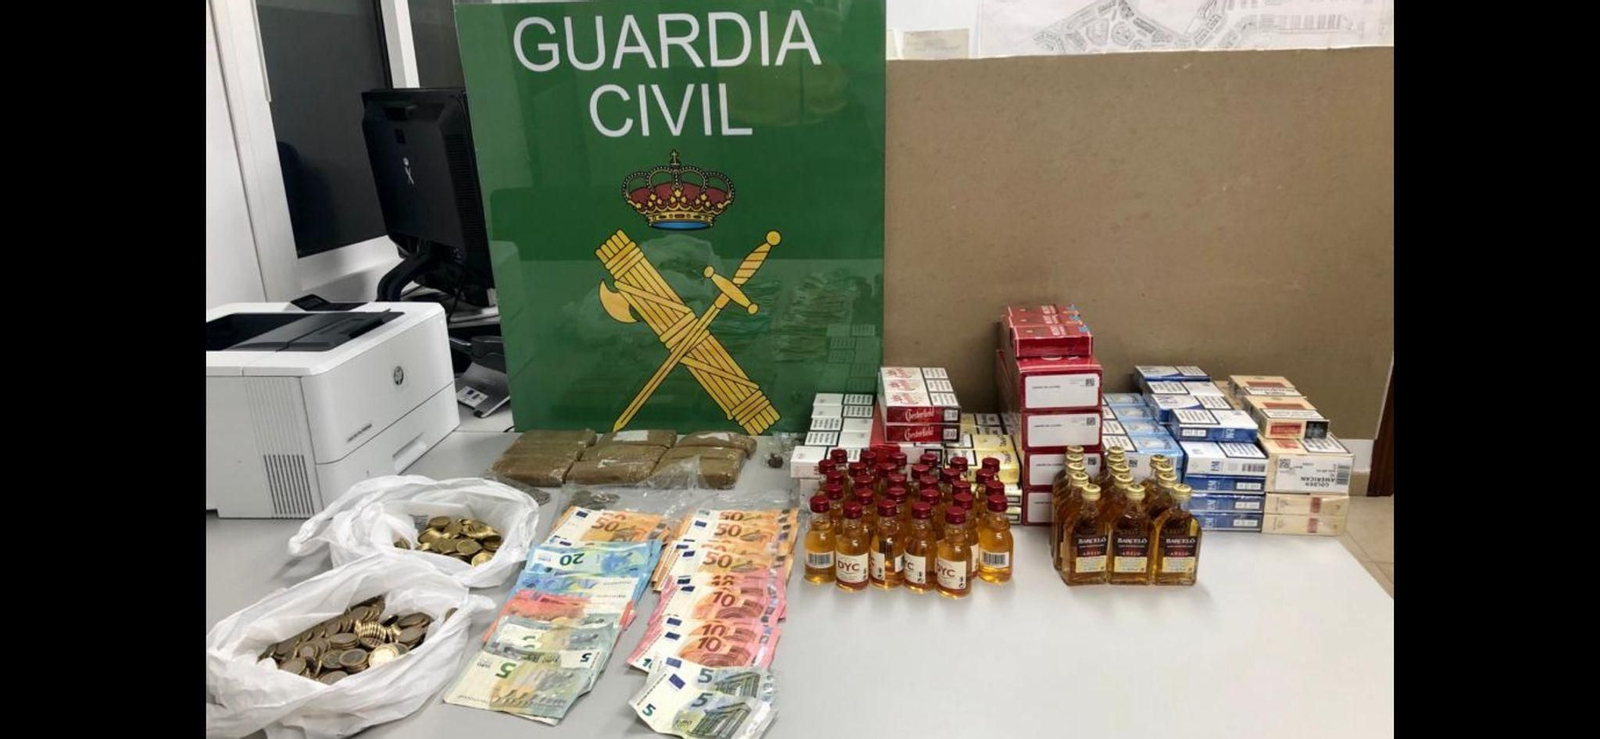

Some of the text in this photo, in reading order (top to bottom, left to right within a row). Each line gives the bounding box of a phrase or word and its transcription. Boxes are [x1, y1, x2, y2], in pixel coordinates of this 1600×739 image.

[513, 10, 822, 72] GUARDIA
[589, 83, 753, 137] CIVIL
[905, 406, 934, 422] Chesterfield
[904, 426, 934, 441] Chesterfield
[719, 511, 744, 521] 50
[591, 517, 620, 532] 50
[714, 523, 742, 537] 50
[560, 553, 585, 567] 20
[702, 551, 733, 568] 50
[837, 560, 860, 571] DYC
[712, 591, 736, 607] 10
[701, 624, 727, 637] 10
[698, 636, 722, 652] 10
[580, 652, 592, 662] 5
[495, 662, 517, 679] 5
[697, 668, 714, 684] 5
[691, 693, 713, 708] 5
[642, 703, 656, 717] 5
